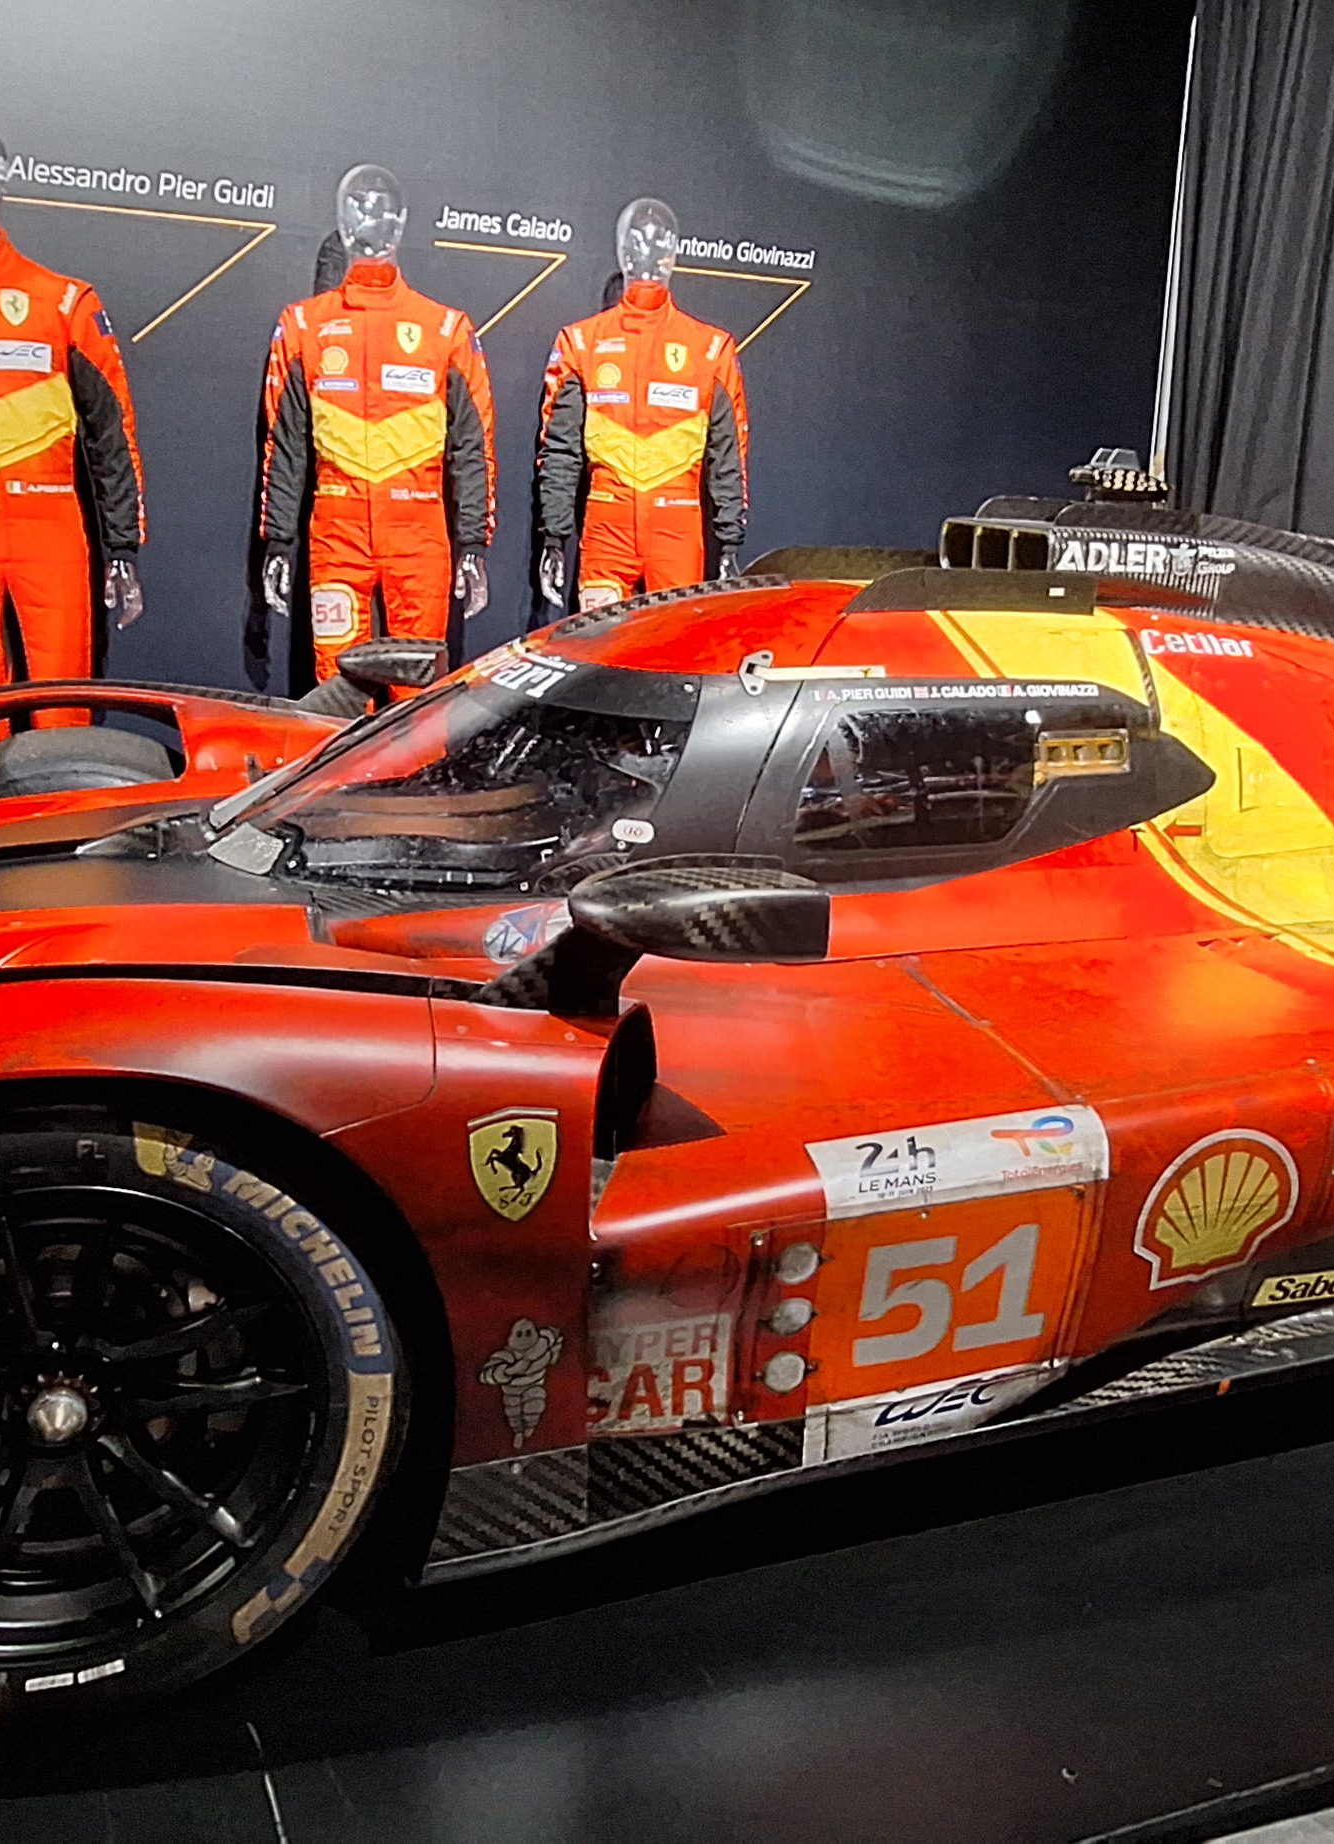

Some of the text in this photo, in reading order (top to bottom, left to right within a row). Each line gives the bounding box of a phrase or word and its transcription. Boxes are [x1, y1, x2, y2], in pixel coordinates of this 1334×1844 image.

[7, 155, 275, 209] Alessandro Pier Guidi
[435, 205, 573, 242] James Calado
[736, 241, 816, 270] Giovinazzi
[1056, 541, 1167, 573] ADLER
[315, 603, 347, 624] 51
[1140, 629, 1254, 658] Cetilar
[874, 687, 912, 699] GUIDI
[858, 1172, 937, 1193] LE MANS
[222, 1170, 382, 1356] MICHELIN
[853, 1223, 1045, 1367] 51
[328, 1395, 380, 1536] PILOT SPORT
